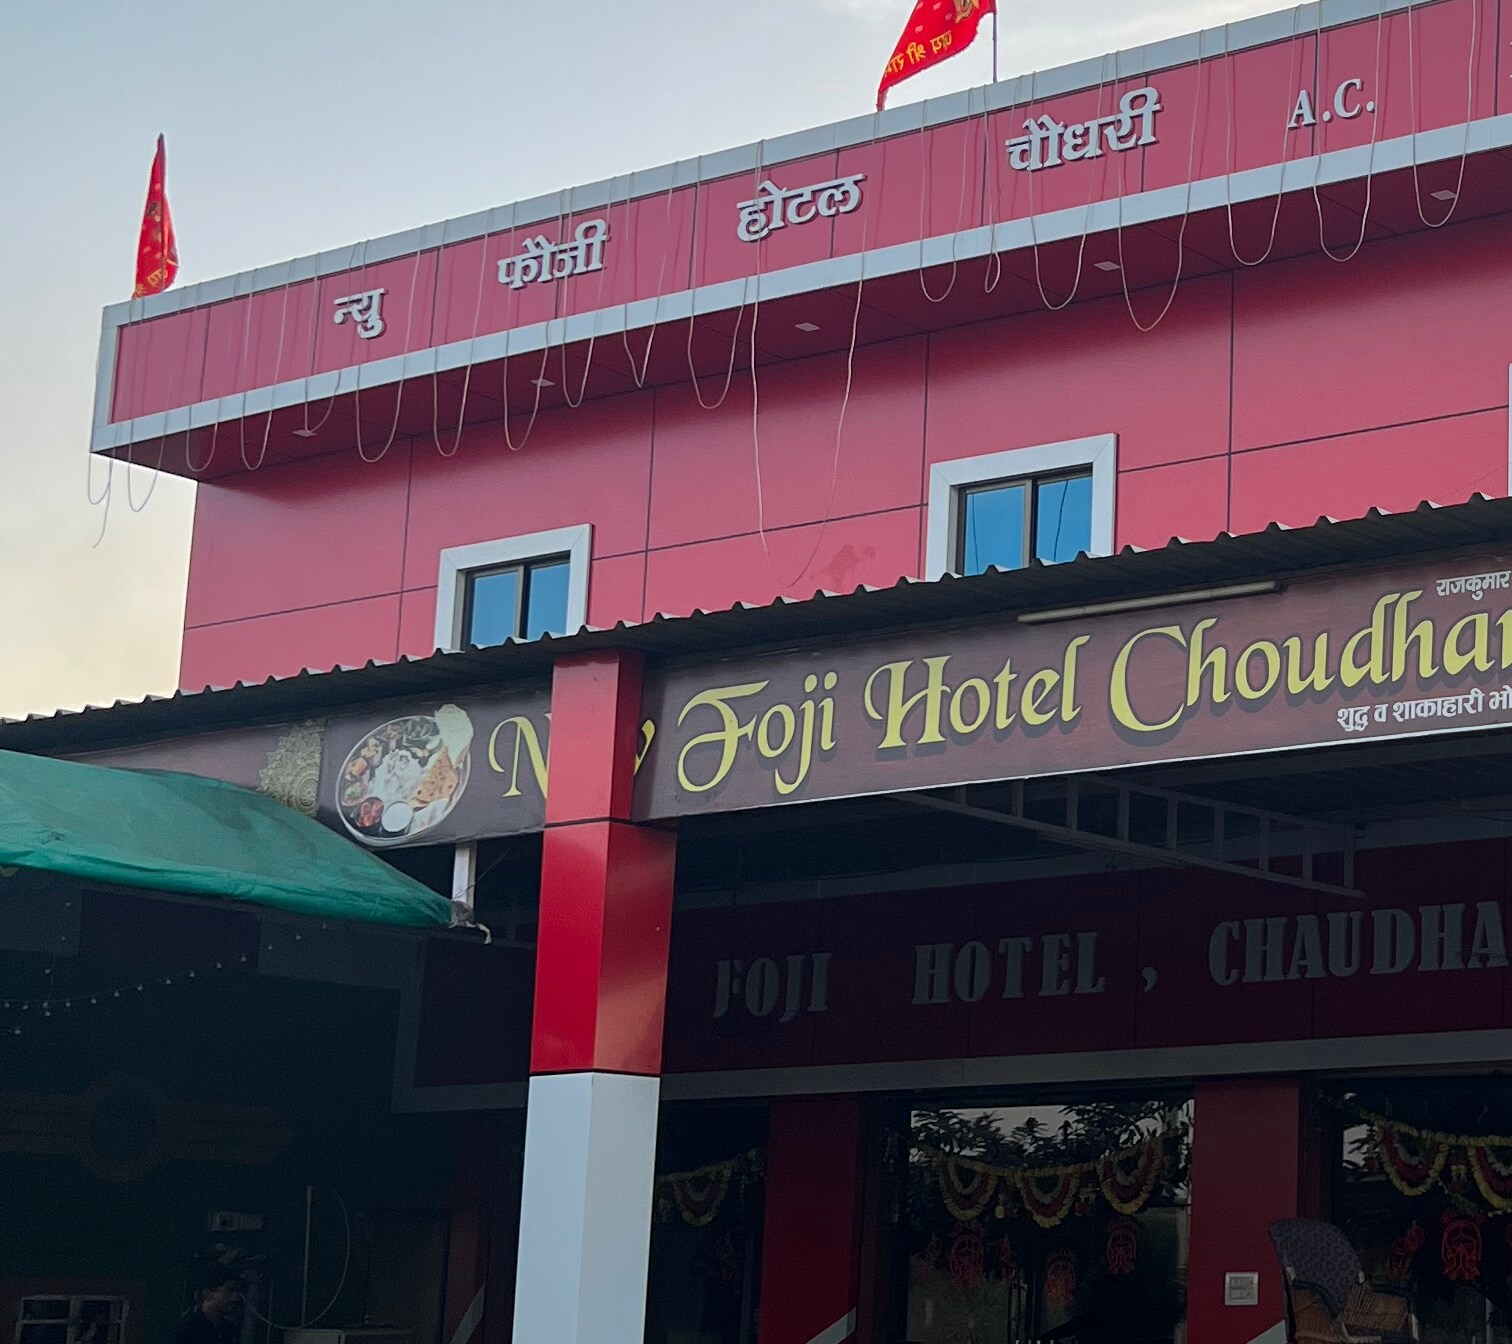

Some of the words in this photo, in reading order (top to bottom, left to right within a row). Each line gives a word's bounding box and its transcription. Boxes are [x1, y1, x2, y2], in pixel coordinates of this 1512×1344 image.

[496, 218, 608, 289] फौजी
[736, 173, 866, 242] होटल
[1005, 86, 1162, 171] चौधरी
[1286, 78, 1376, 129] A.C.
[1436, 570, 1512, 601] राजकुमार
[677, 671, 838, 795] Foji
[863, 635, 1091, 749] Hotel
[1374, 703, 1389, 723] व
[1392, 687, 1486, 722] शाकाहारी
[911, 931, 1106, 1005] HOTEL
